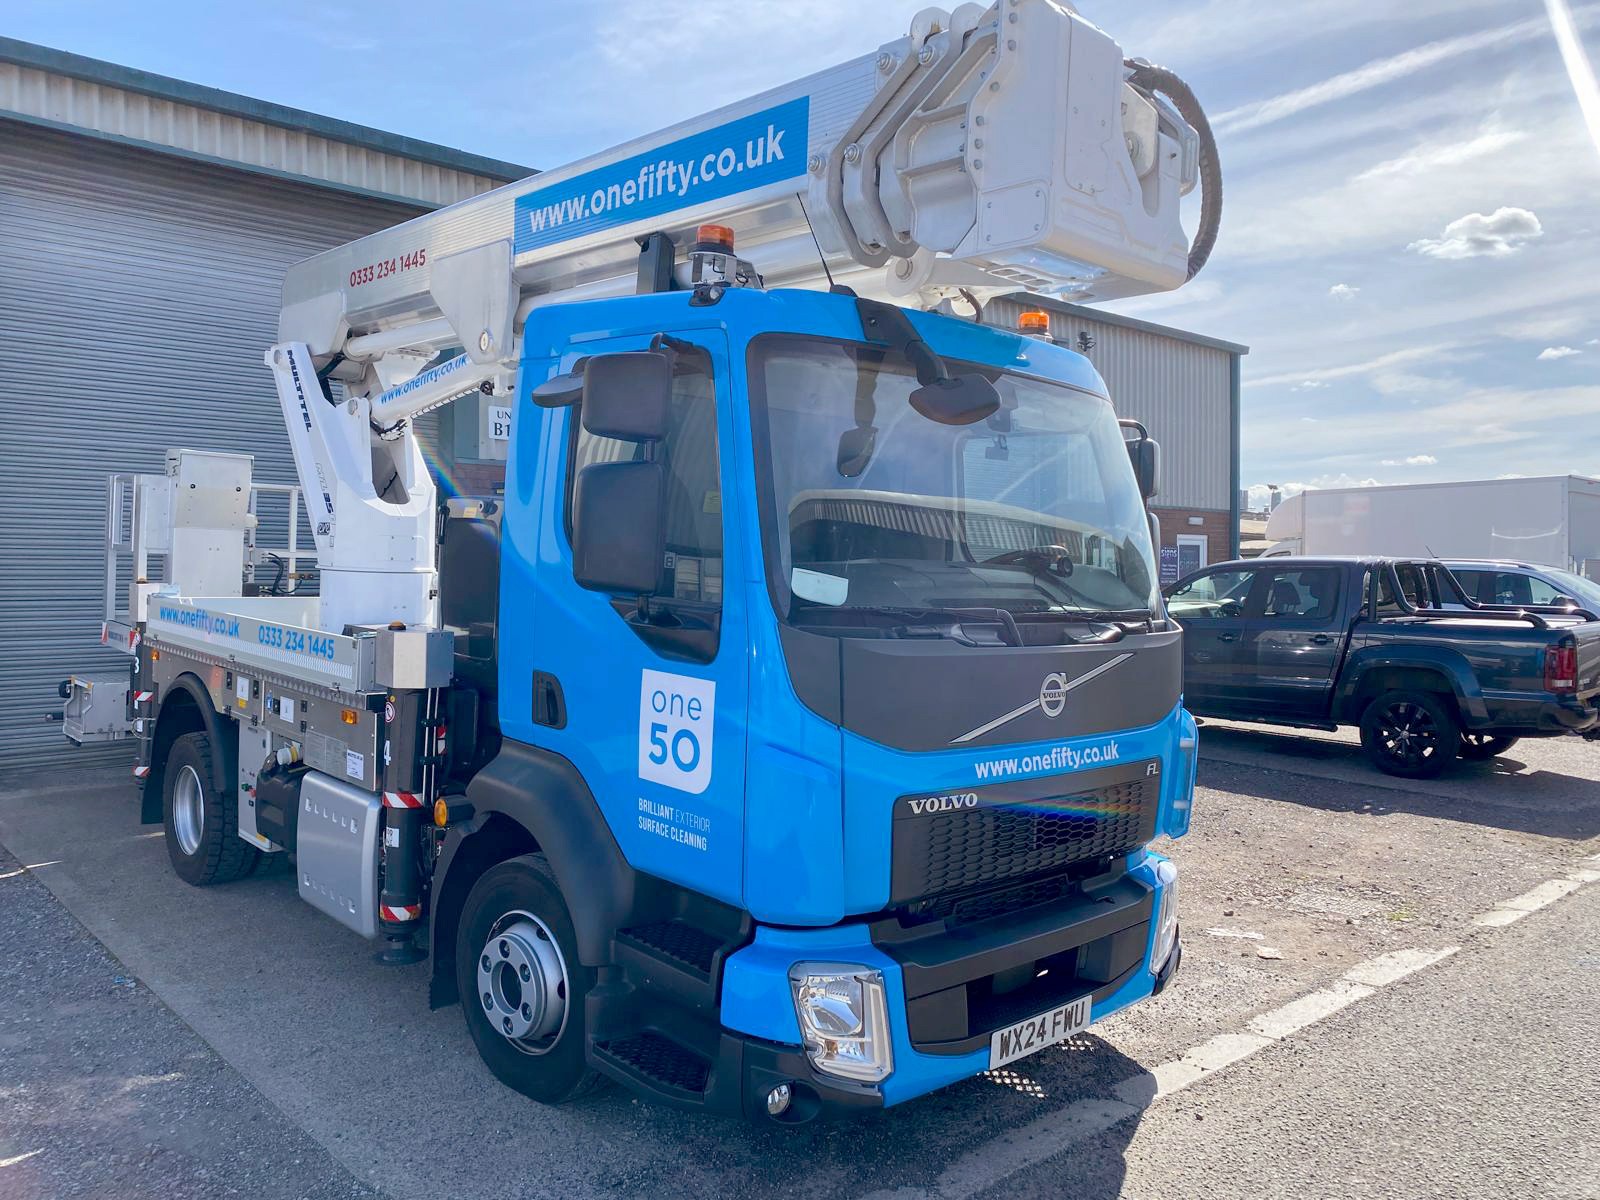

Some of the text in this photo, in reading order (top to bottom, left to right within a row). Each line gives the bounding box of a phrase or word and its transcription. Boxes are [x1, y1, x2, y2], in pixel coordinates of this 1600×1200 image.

[529, 124, 785, 233] www.onefifty.co.uk
[350, 248, 426, 287] 0333 234 1445
[287, 349, 312, 433] MULTITEL
[380, 356, 468, 405] www.onefifty.co.uk
[159, 606, 335, 660] www.onefifty.co.uk 0333 234 1445
[652, 690, 702, 721] one
[1042, 691, 1067, 700] VOLVO
[384, 740, 391, 766] 4
[648, 722, 700, 773] 50
[974, 740, 1120, 780] www.onefifty.co.uk
[1146, 763, 1159, 777] FL
[638, 797, 710, 833] BRILLIANT EXTERIOR
[908, 792, 978, 815] VOLVO
[638, 815, 707, 851] SURFACE CLEANING
[999, 1001, 1085, 1060] WX24 FWU
